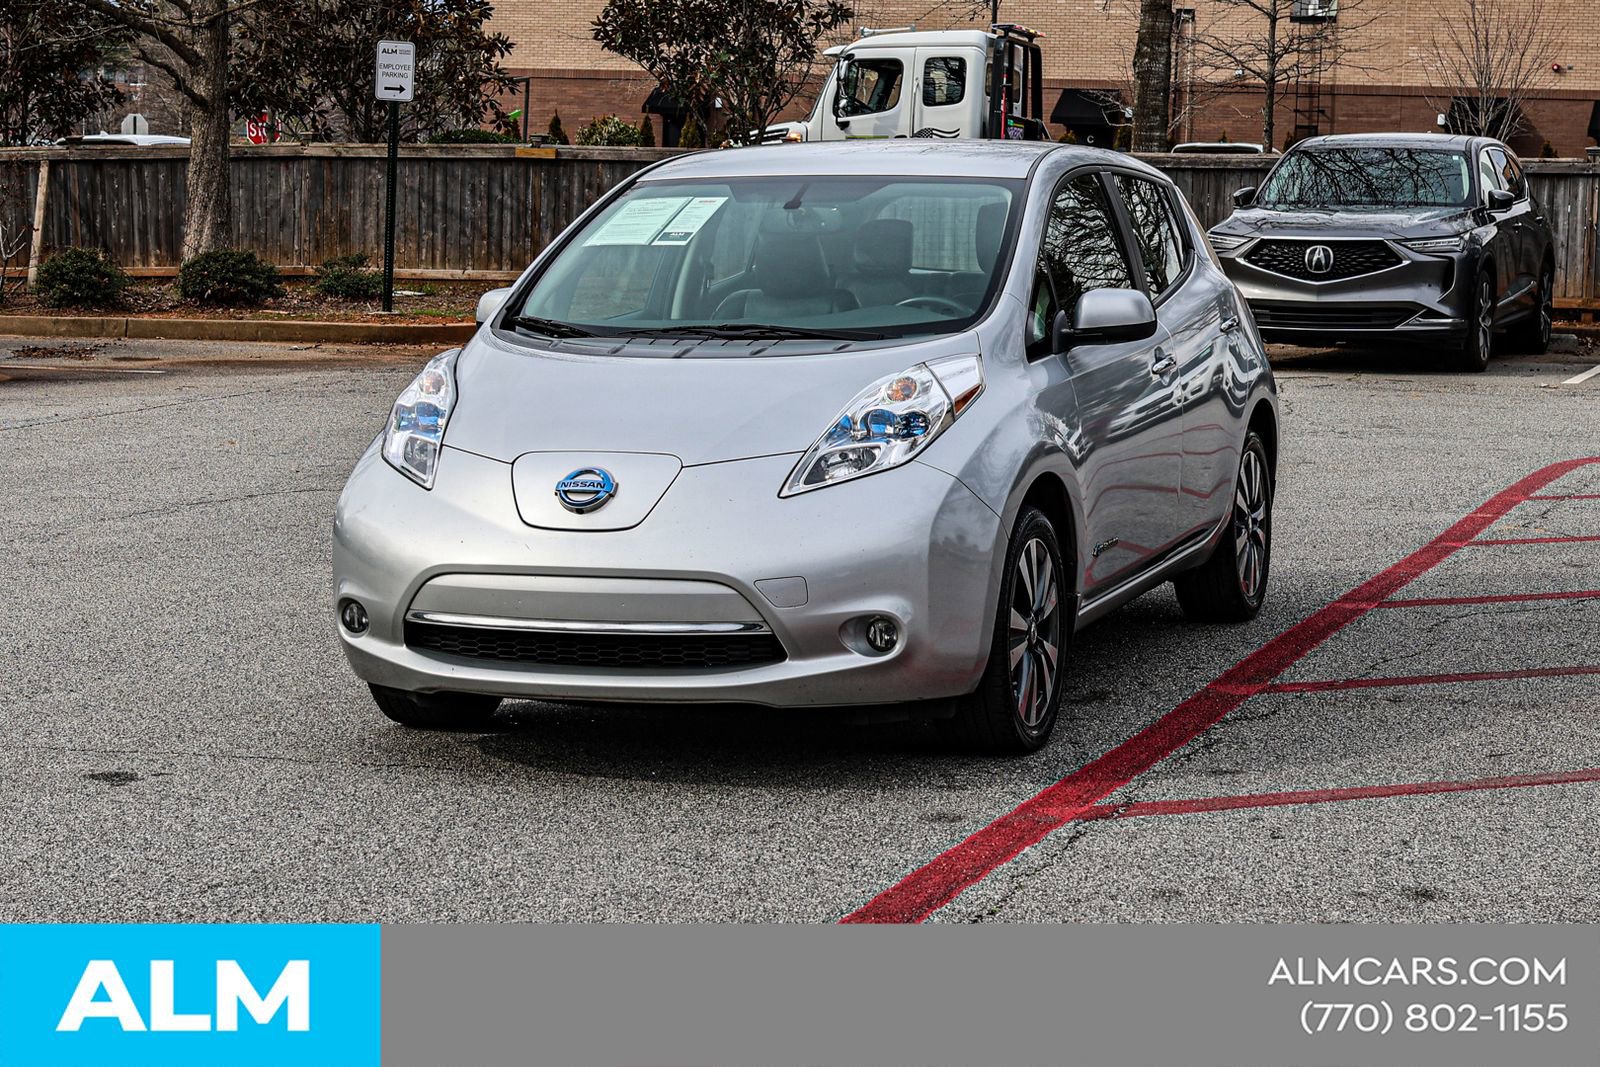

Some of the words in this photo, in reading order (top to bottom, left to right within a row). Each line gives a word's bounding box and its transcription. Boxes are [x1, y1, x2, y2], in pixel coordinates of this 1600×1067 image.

[381, 47, 398, 55] ALM
[379, 63, 412, 71] EMPLOYEE
[382, 71, 408, 79] PARKING
[560, 481, 606, 489] NISSAN
